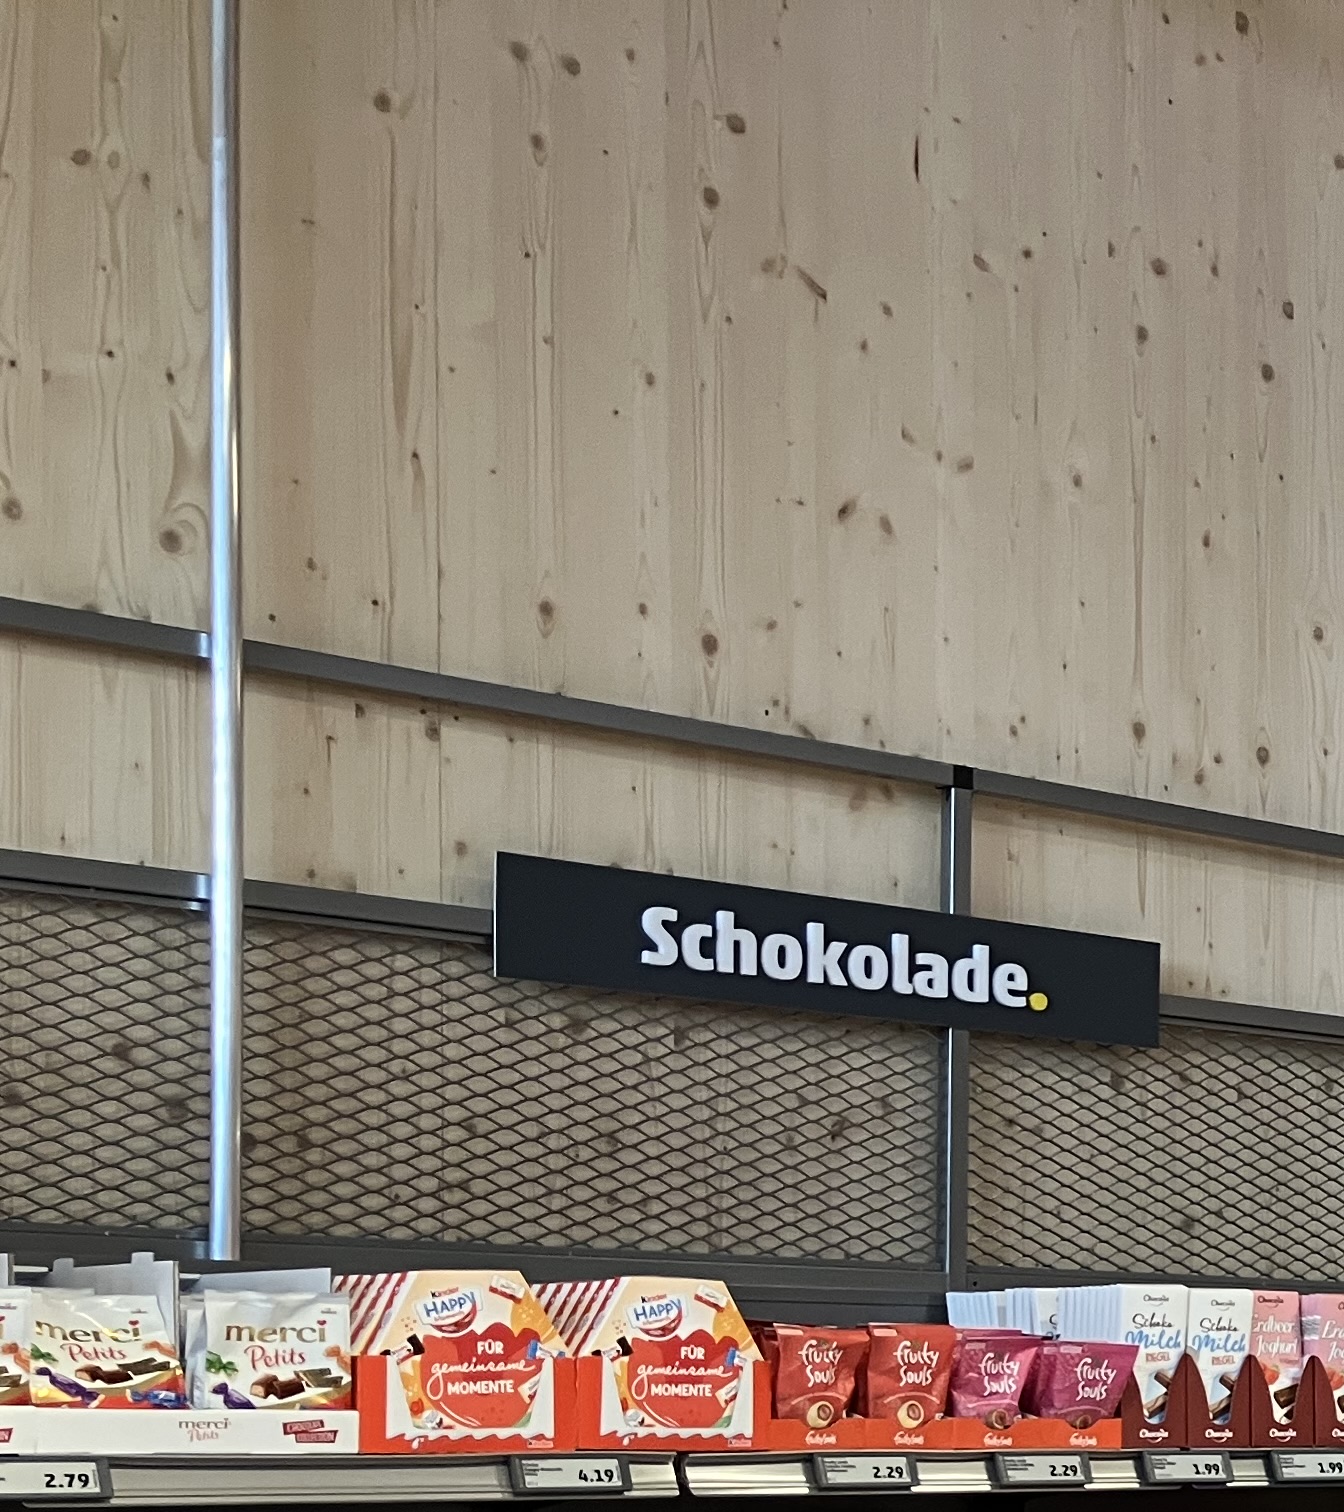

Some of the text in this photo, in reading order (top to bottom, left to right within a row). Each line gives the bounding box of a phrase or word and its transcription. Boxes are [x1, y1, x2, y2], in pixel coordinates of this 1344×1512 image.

[640, 906, 1049, 1012] Schokolade.
[423, 1291, 477, 1318] HAPPY
[633, 1298, 682, 1322] HAPPY
[34, 1319, 142, 1344] merci
[225, 1319, 327, 1343] merci
[60, 1341, 128, 1363] Petits
[477, 1338, 504, 1355] FÜR
[680, 1344, 705, 1360] FÜR
[244, 1344, 307, 1369] Petits
[427, 1359, 536, 1399] gemeinsame
[447, 1379, 514, 1395] MOMENTE
[631, 1363, 733, 1400] gemeinsame
[650, 1383, 712, 1397] MOMENTE
[578, 1468, 614, 1483] 4.19
[873, 1466, 903, 1479] 2.29
[1050, 1464, 1077, 1477] 2.29
[1192, 1463, 1220, 1475] 1.99
[1318, 1462, 1343, 1474] 1.99
[44, 1473, 90, 1489] 2.79
